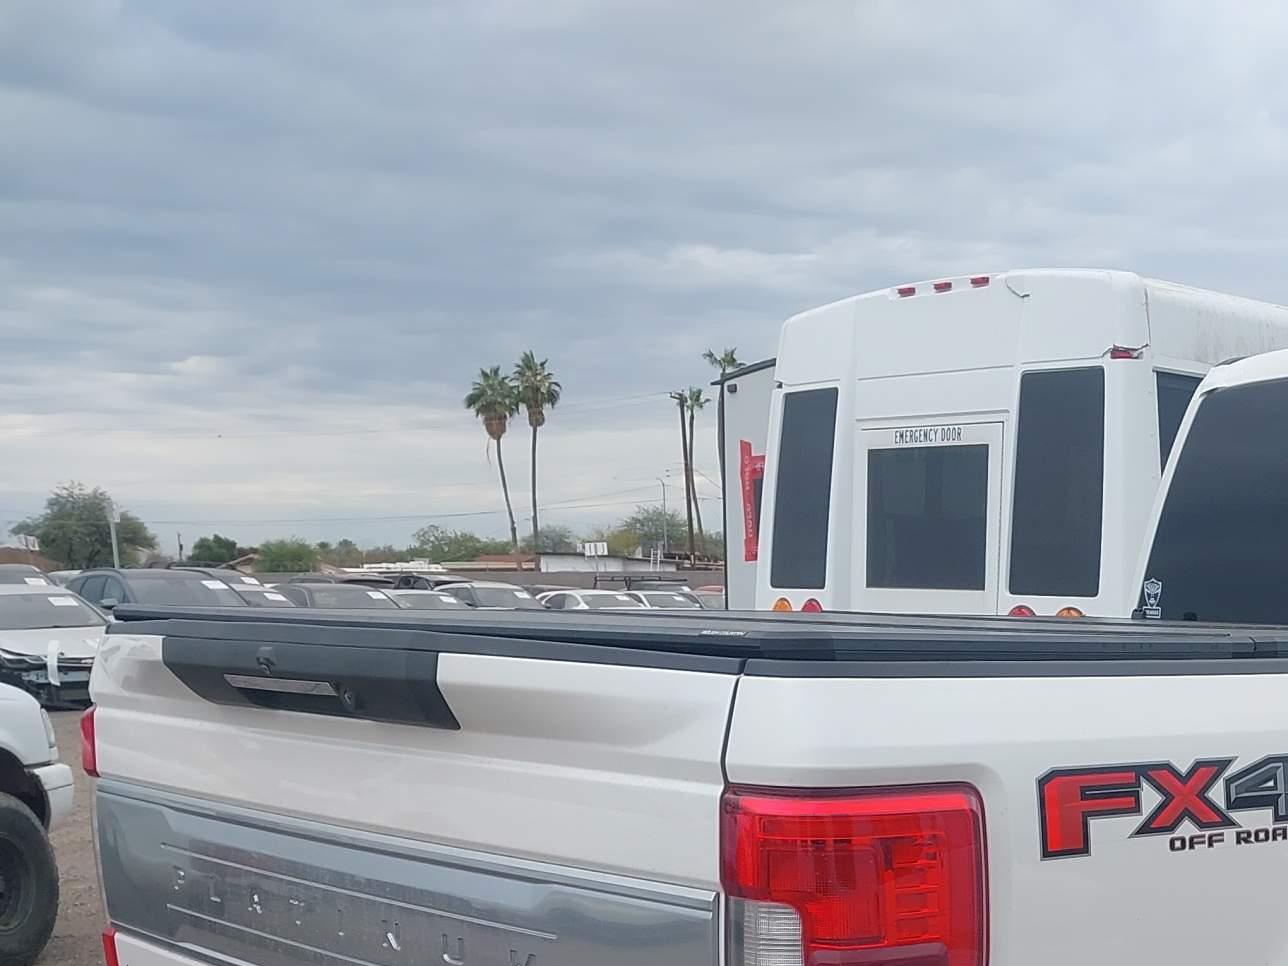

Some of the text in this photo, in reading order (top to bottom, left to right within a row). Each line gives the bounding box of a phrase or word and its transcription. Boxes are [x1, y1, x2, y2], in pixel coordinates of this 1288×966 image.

[894, 426, 962, 444] EMERGENCY DOOR
[1168, 831, 1226, 852] OFF
